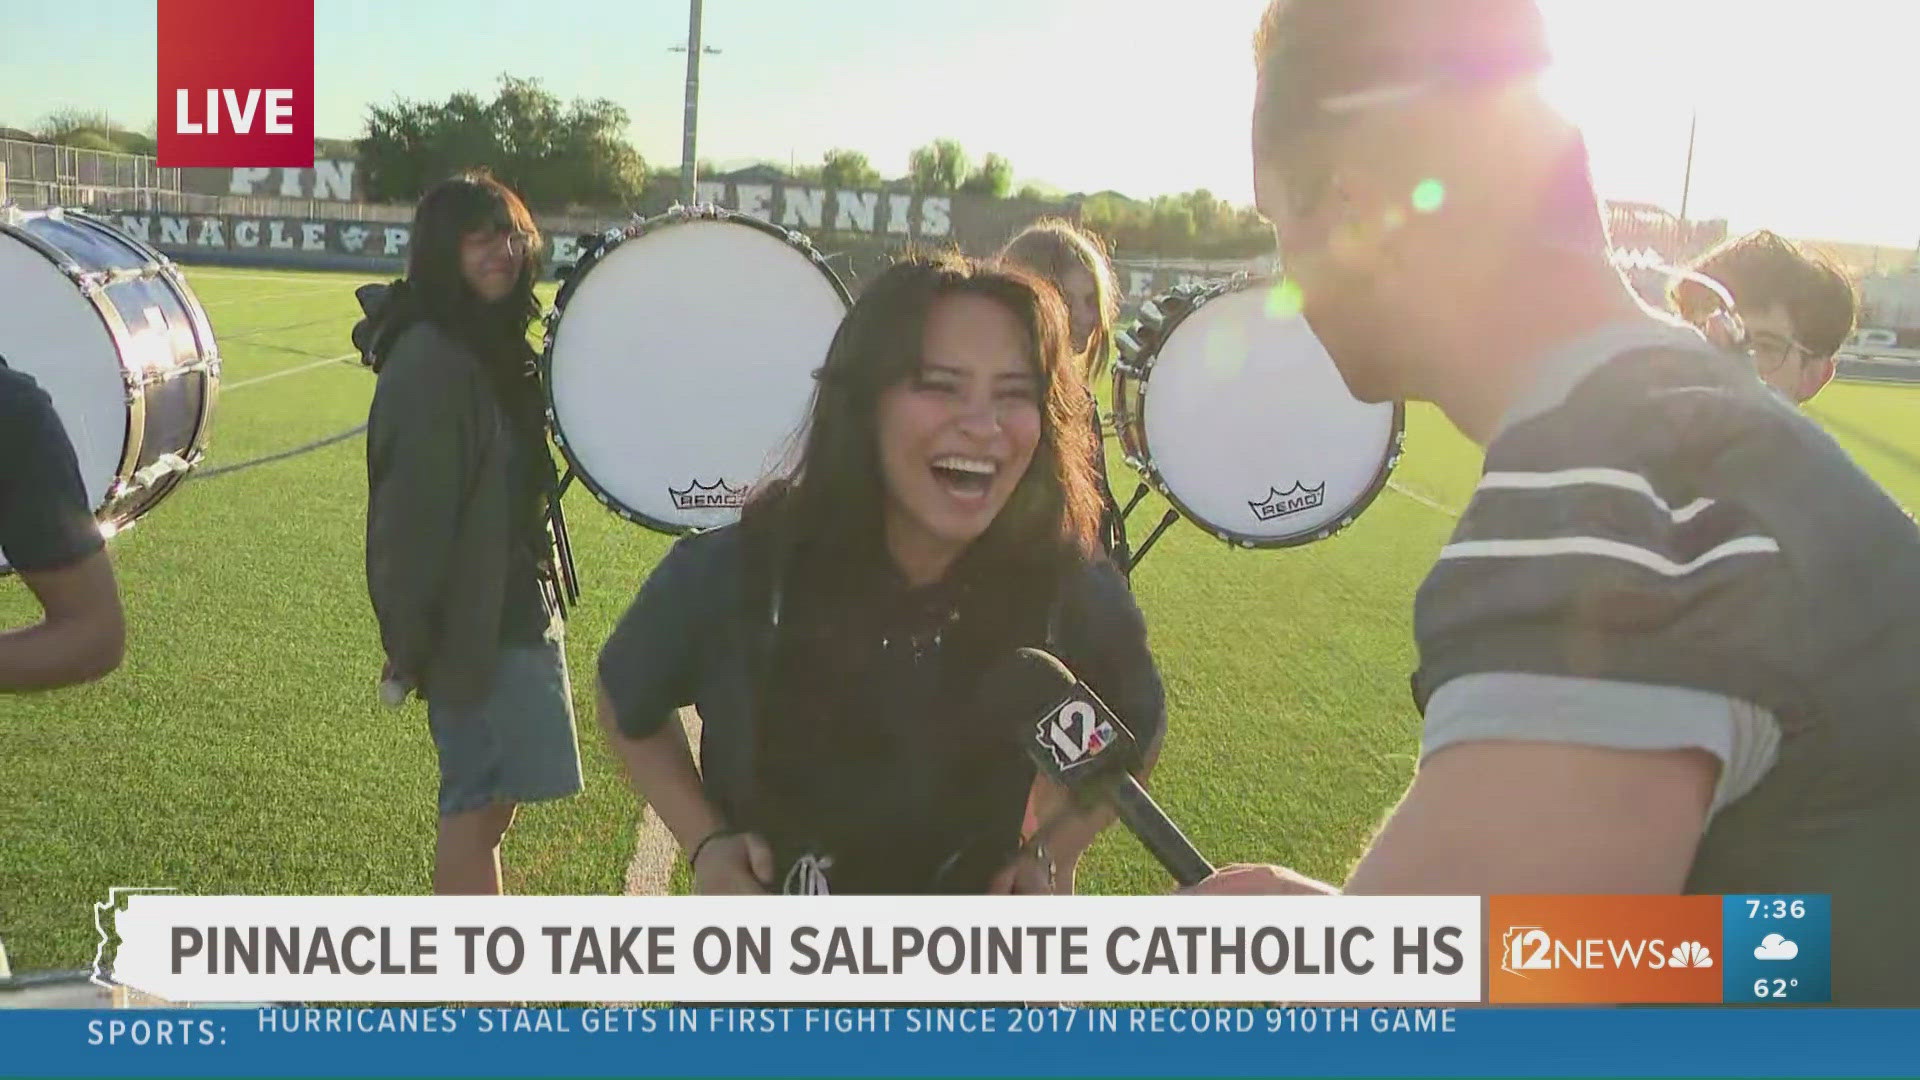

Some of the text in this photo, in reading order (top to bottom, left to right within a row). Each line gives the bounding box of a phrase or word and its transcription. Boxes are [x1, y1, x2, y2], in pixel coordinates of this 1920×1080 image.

[99, 212, 326, 250] NNACLE
[696, 181, 950, 236] TENNIS
[1261, 492, 1318, 517] REMO
[1050, 700, 1097, 762] 12
